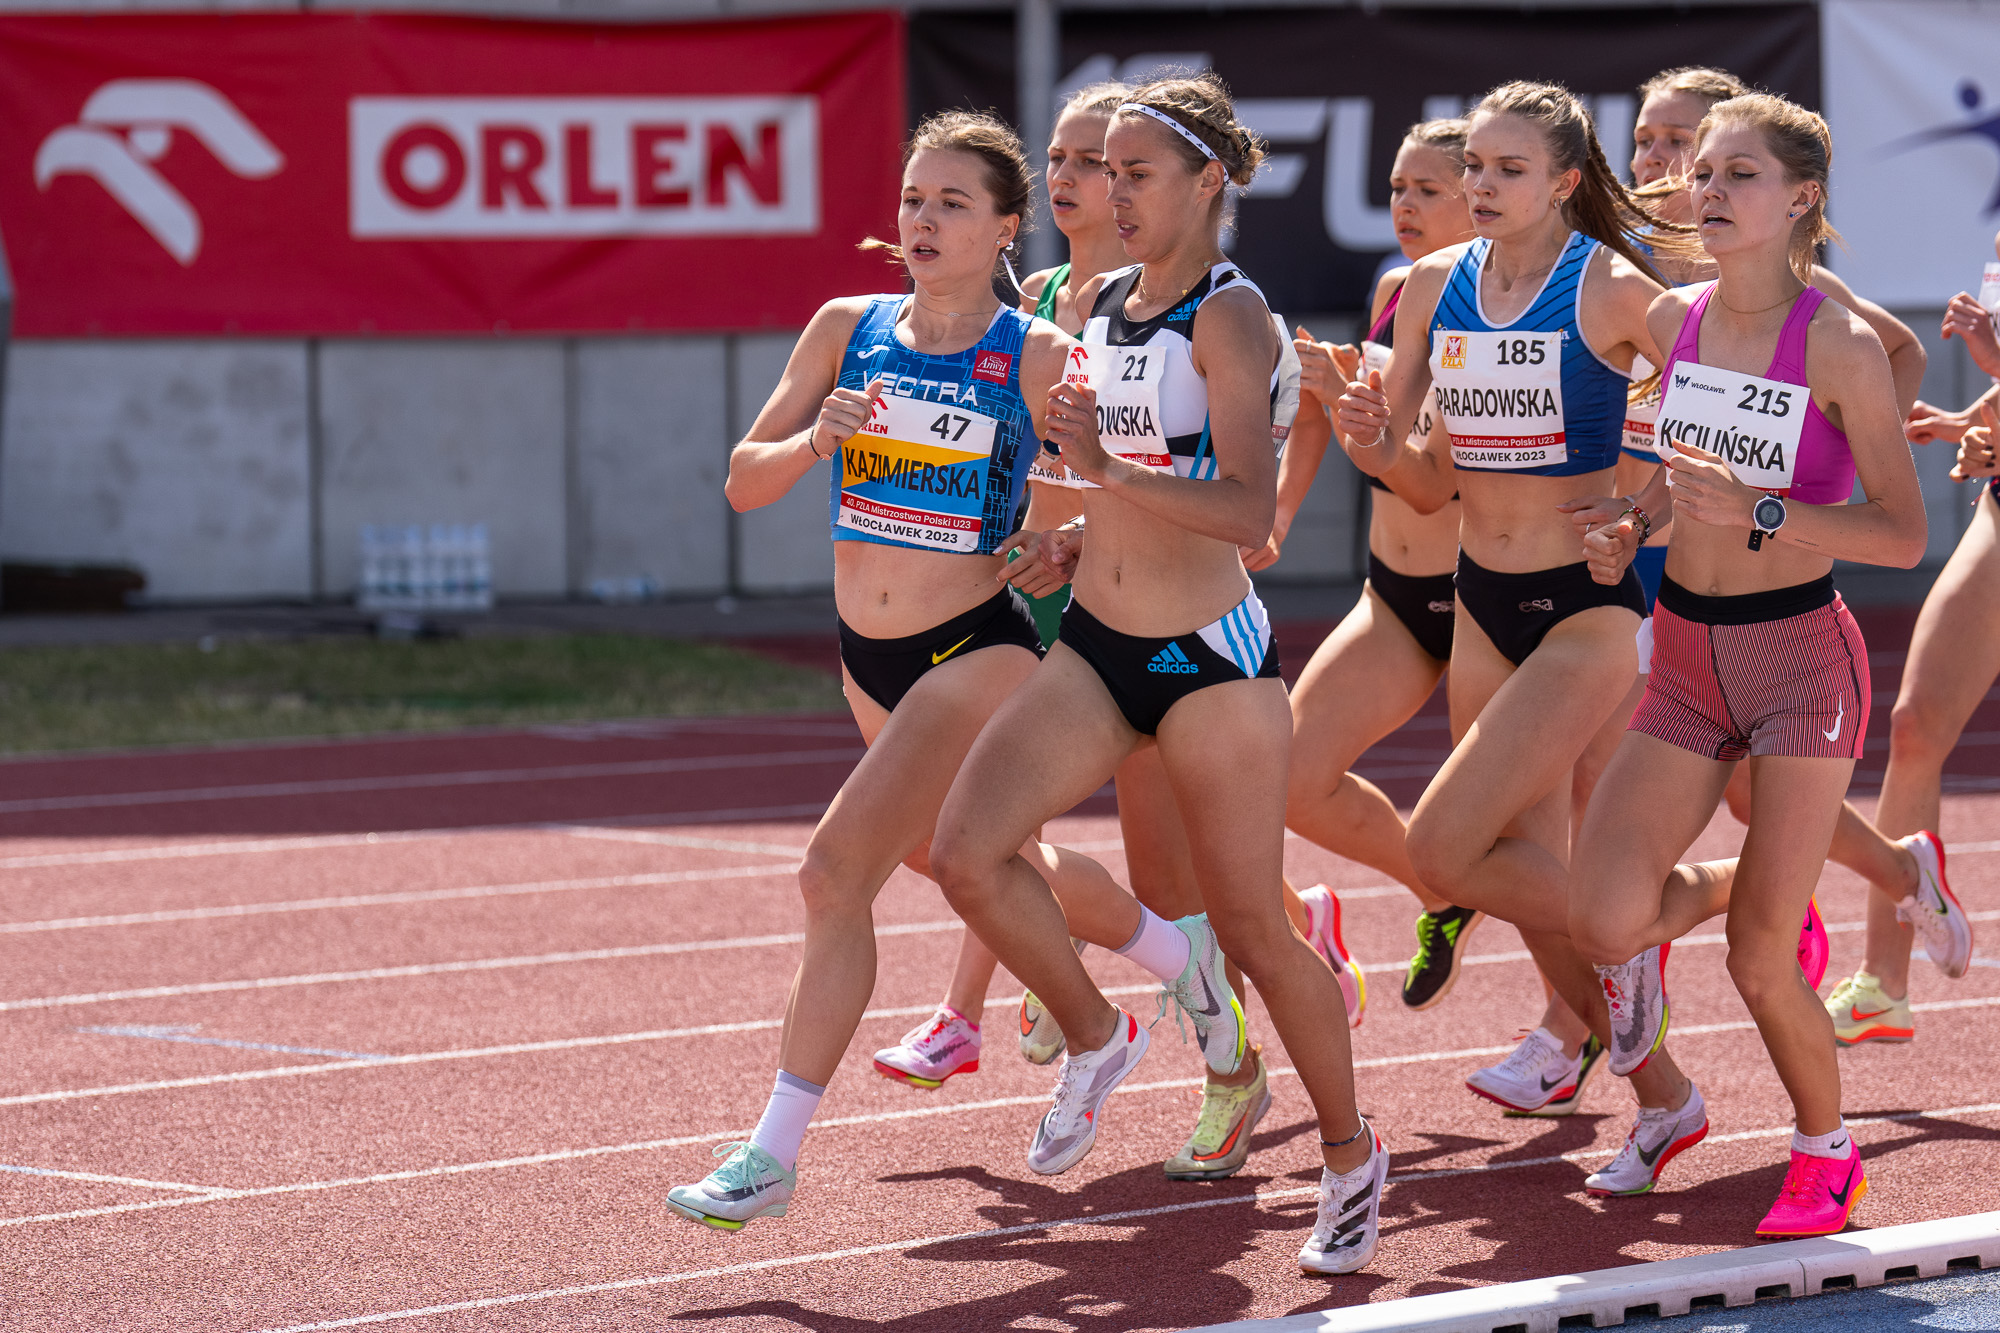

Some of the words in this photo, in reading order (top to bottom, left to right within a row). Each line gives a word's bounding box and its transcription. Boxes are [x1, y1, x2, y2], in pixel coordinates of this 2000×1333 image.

[380, 119, 783, 212] ORLEN
[977, 355, 1007, 372] Anwil
[1442, 357, 1463, 367] PZLA
[1497, 339, 1546, 365] 185
[1067, 373, 1089, 384] ORLEN
[1121, 354, 1148, 382] 21
[863, 370, 978, 406] VECTRA
[1435, 387, 1558, 417] PARADOWSKA
[1691, 381, 1726, 395] WŁOCŁAWEK
[1737, 384, 1792, 418] 215
[859, 422, 889, 434] RLEN
[930, 413, 972, 441] 47
[1096, 405, 1157, 436] OWSKA
[1465, 437, 1509, 447] Mistrzostwa
[1510, 436, 1536, 447] Polski
[1537, 435, 1556, 445] U23
[1514, 450, 1546, 461] 2023
[845, 446, 980, 500] KAZIMIERSKA
[846, 497, 855, 508] 40.
[856, 500, 870, 512] PZLA
[871, 505, 922, 522] Mistrzostwa
[923, 514, 951, 527] Polski
[953, 519, 972, 530] U23
[850, 513, 922, 538] WŁOCŁAWEK
[925, 529, 958, 544] 2023
[1147, 661, 1199, 674] adidas
